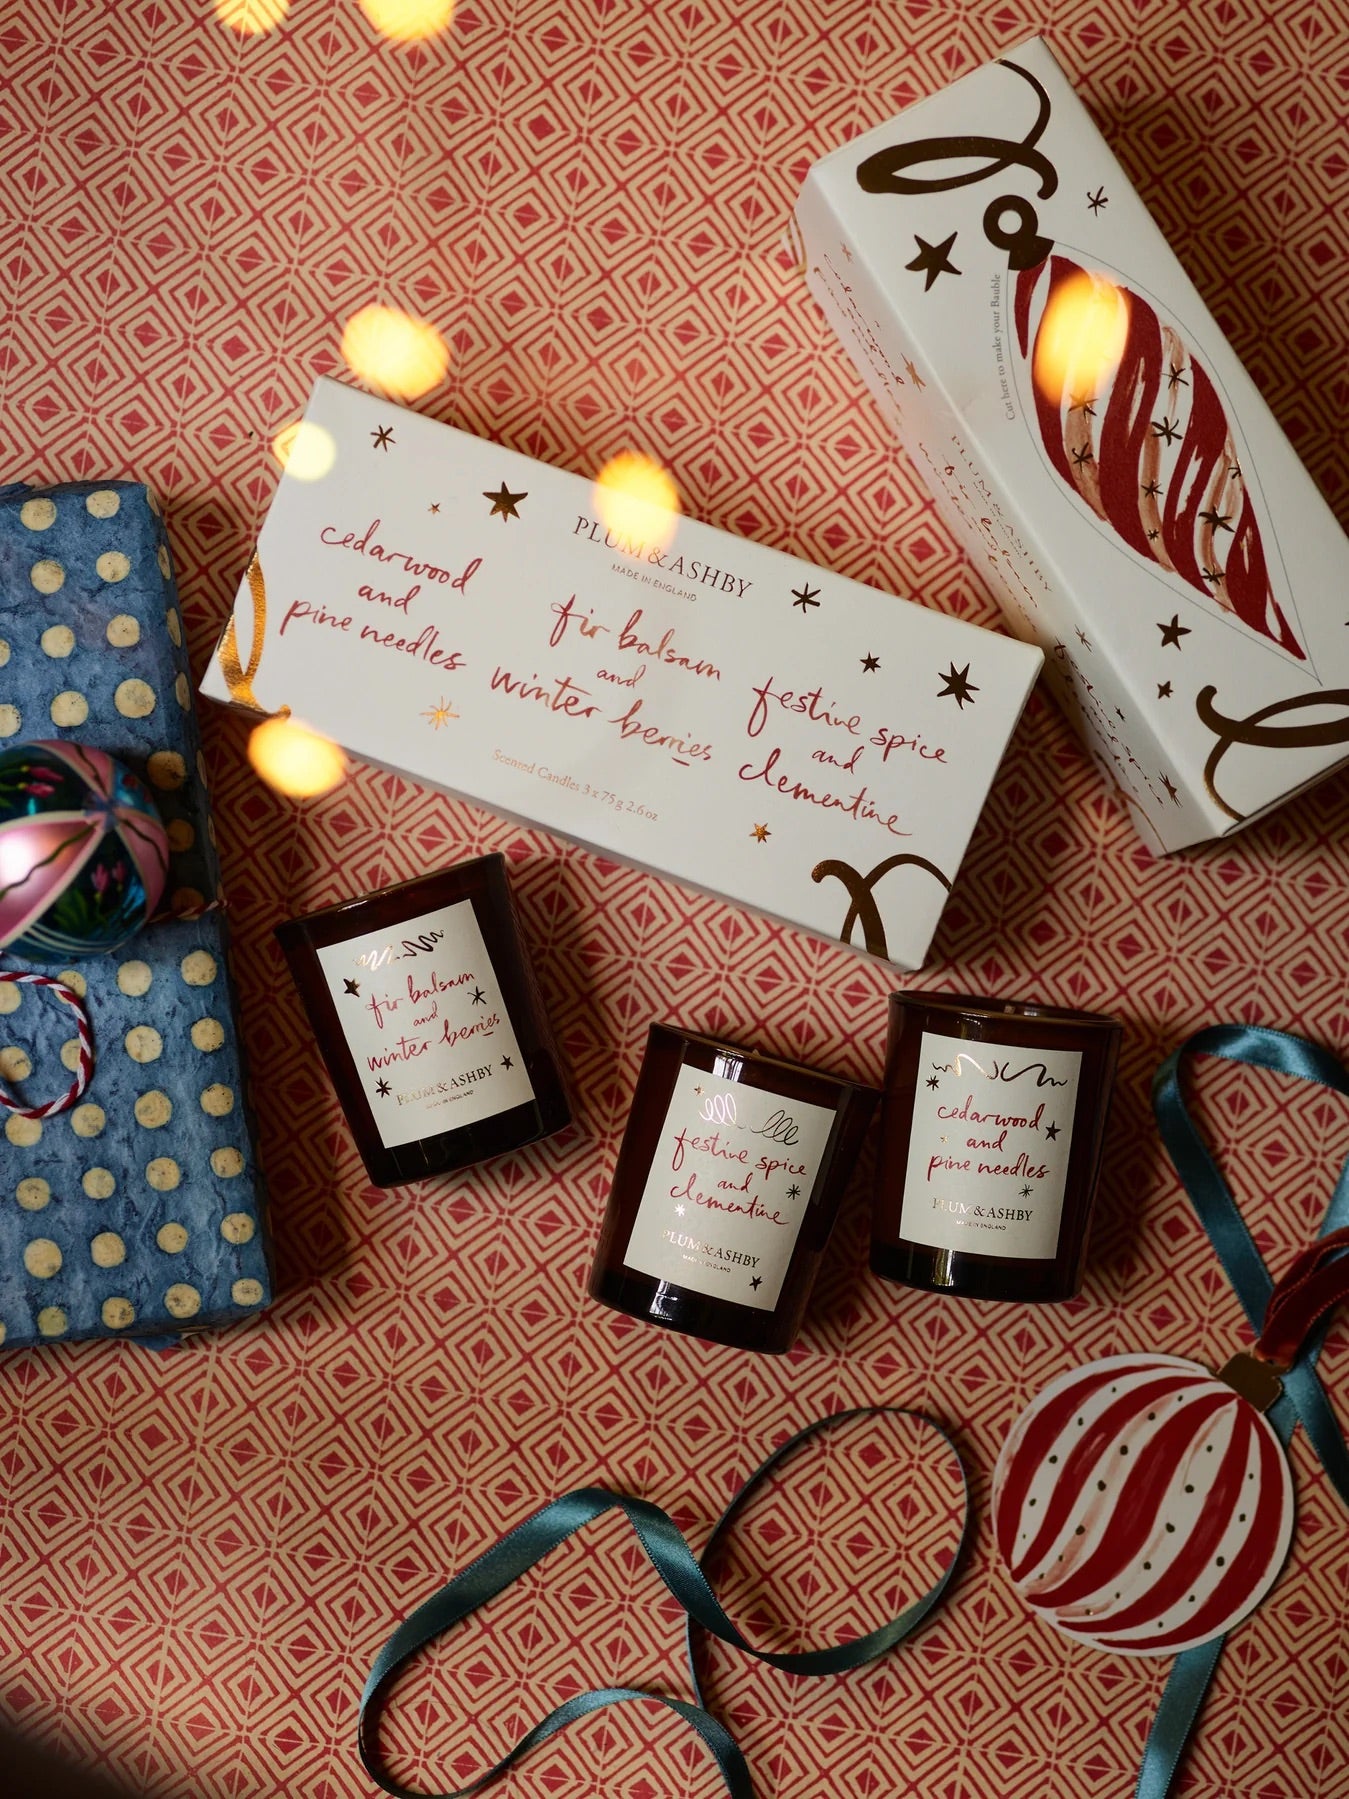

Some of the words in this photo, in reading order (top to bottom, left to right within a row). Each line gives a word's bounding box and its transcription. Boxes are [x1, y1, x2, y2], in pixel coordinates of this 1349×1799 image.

[990, 274, 1001, 308] Bauble
[992, 310, 1004, 333] your
[992, 335, 1003, 362] make
[997, 365, 1008, 377] to
[1000, 378, 1011, 401] here
[1005, 401, 1016, 421] Cut
[320, 519, 483, 596] cedarwood
[572, 515, 647, 560] PLUM
[648, 546, 669, 568] &
[668, 556, 755, 600] ASHBY
[357, 583, 421, 614] and
[611, 563, 639, 580] MADE
[641, 574, 652, 586] IN
[653, 578, 698, 602] ENGLAND
[279, 599, 351, 636] pine
[360, 625, 468, 672] needles
[549, 593, 612, 648] fir
[617, 609, 722, 682] balsam
[596, 664, 647, 689] and
[490, 665, 603, 719] winter
[607, 700, 712, 765] berries
[746, 676, 863, 738] festive
[870, 726, 949, 764] spice
[812, 745, 865, 776] and
[492, 748, 536, 775] Scented
[537, 765, 580, 792] Candles
[581, 783, 591, 796] 3
[592, 788, 600, 799] x
[626, 800, 645, 817] 2.6
[738, 747, 913, 837] clementine
[365, 991, 404, 1030] fir
[407, 971, 476, 1005] balsam
[412, 1001, 440, 1028] and
[366, 1035, 433, 1073] winter
[439, 1012, 501, 1048] berries
[436, 1082, 448, 1094] &
[450, 1064, 494, 1090] ASHBY
[936, 1094, 1046, 1131] cedarwood
[671, 1127, 750, 1172] festive
[755, 1156, 808, 1180] spice
[966, 1130, 1008, 1152] and
[717, 1172, 755, 1194] and
[926, 1154, 971, 1181] pine
[977, 1152, 1051, 1179] needles
[669, 1172, 791, 1227] clementine
[973, 1205, 985, 1217] &
[986, 1207, 1033, 1222] ASHBY
[662, 1229, 701, 1252] PLUM
[714, 1247, 761, 1268] ASHBY
